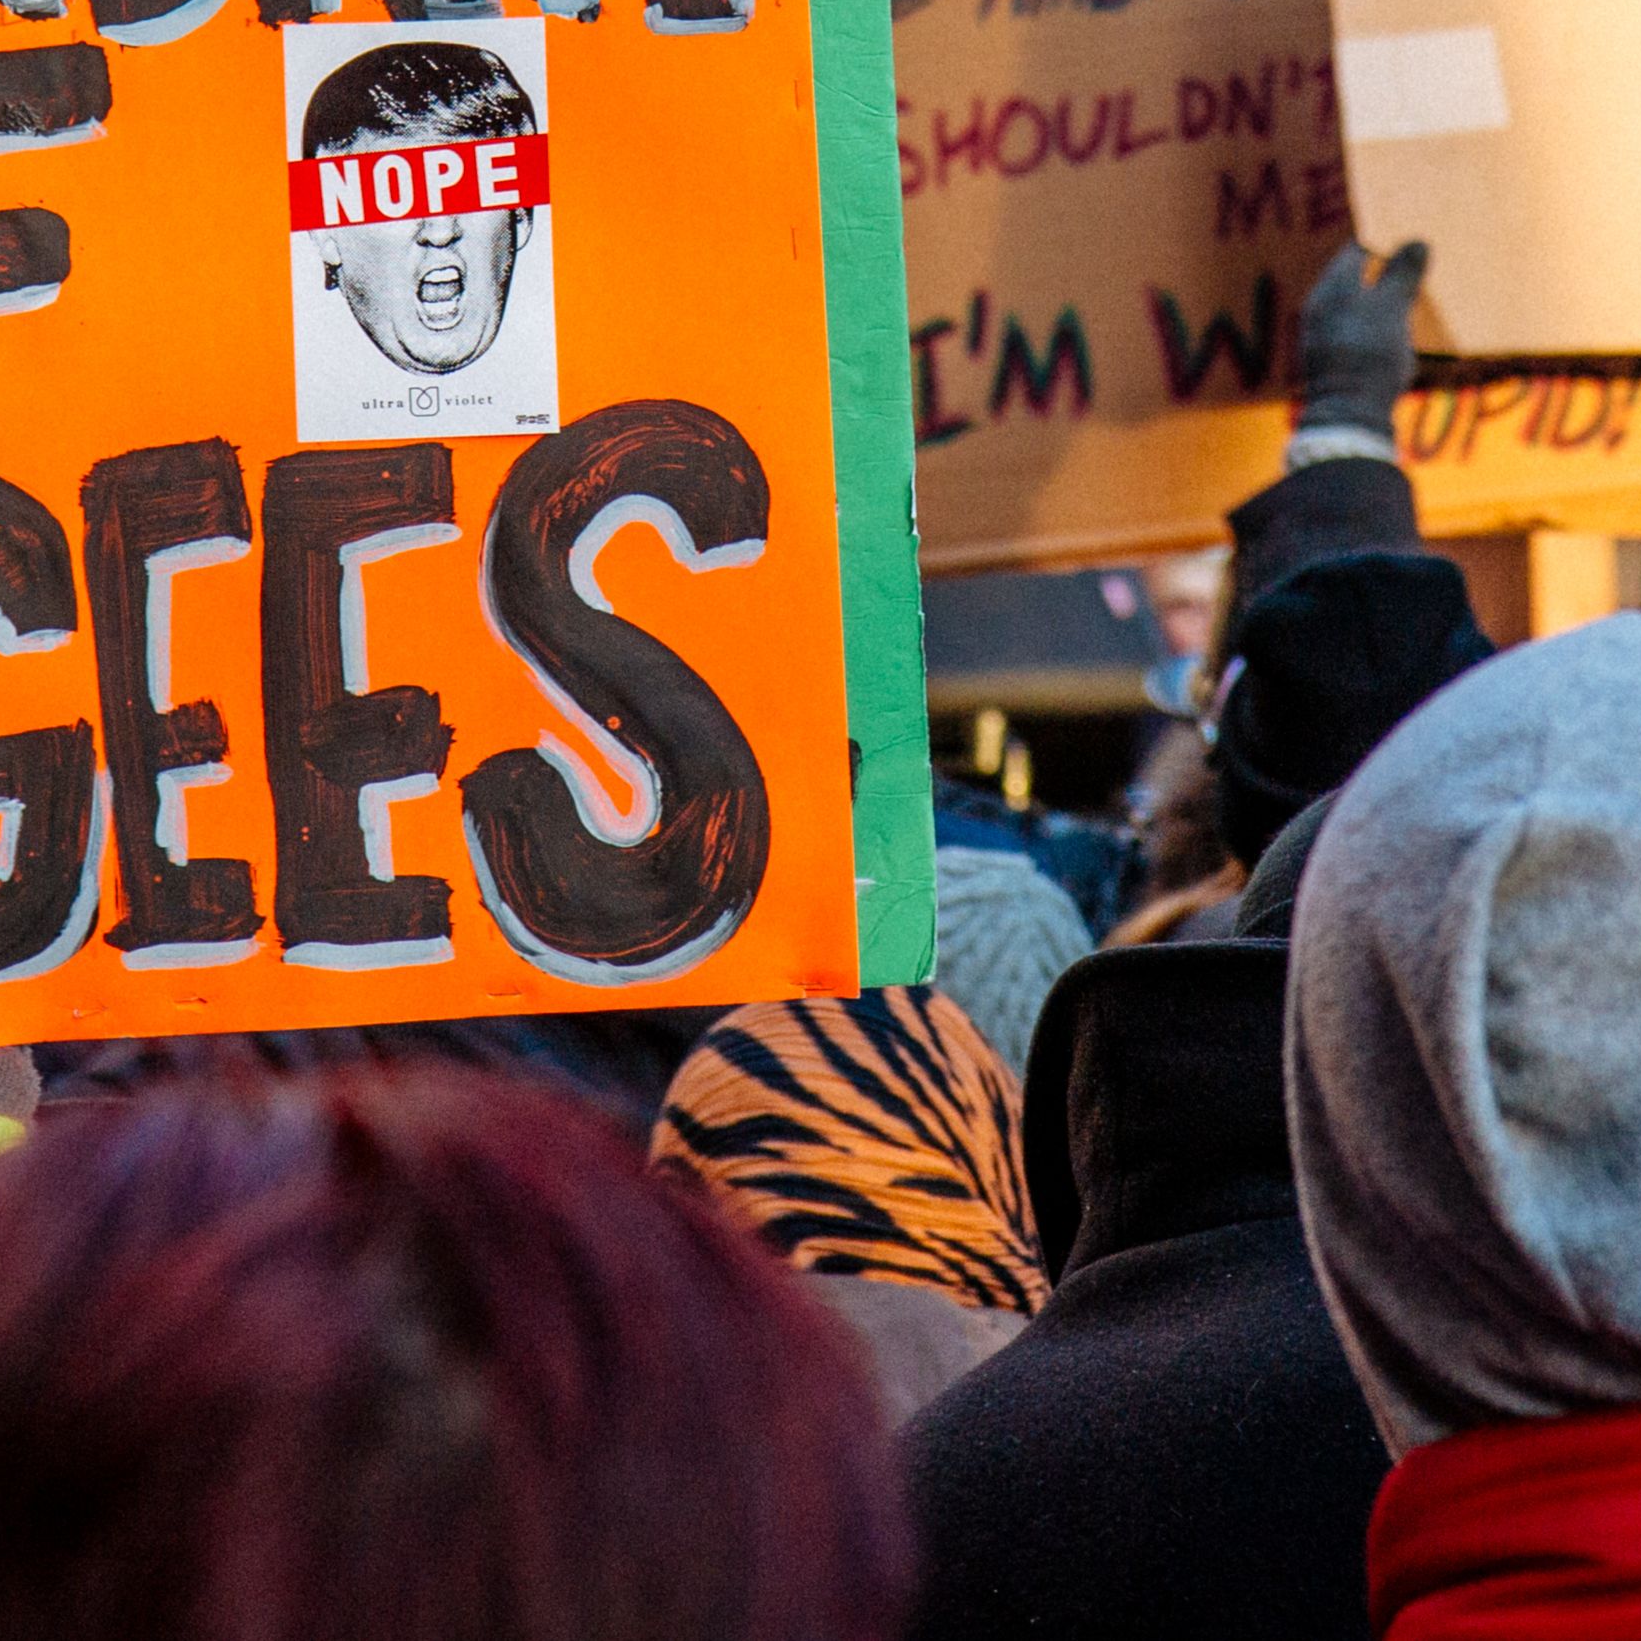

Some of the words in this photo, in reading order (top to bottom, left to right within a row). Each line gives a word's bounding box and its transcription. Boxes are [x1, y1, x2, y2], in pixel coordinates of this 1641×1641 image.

[318, 141, 521, 226] NOPE
[361, 396, 404, 411] ultra
[445, 394, 493, 407] violet
[911, 288, 1094, 447] I'M
